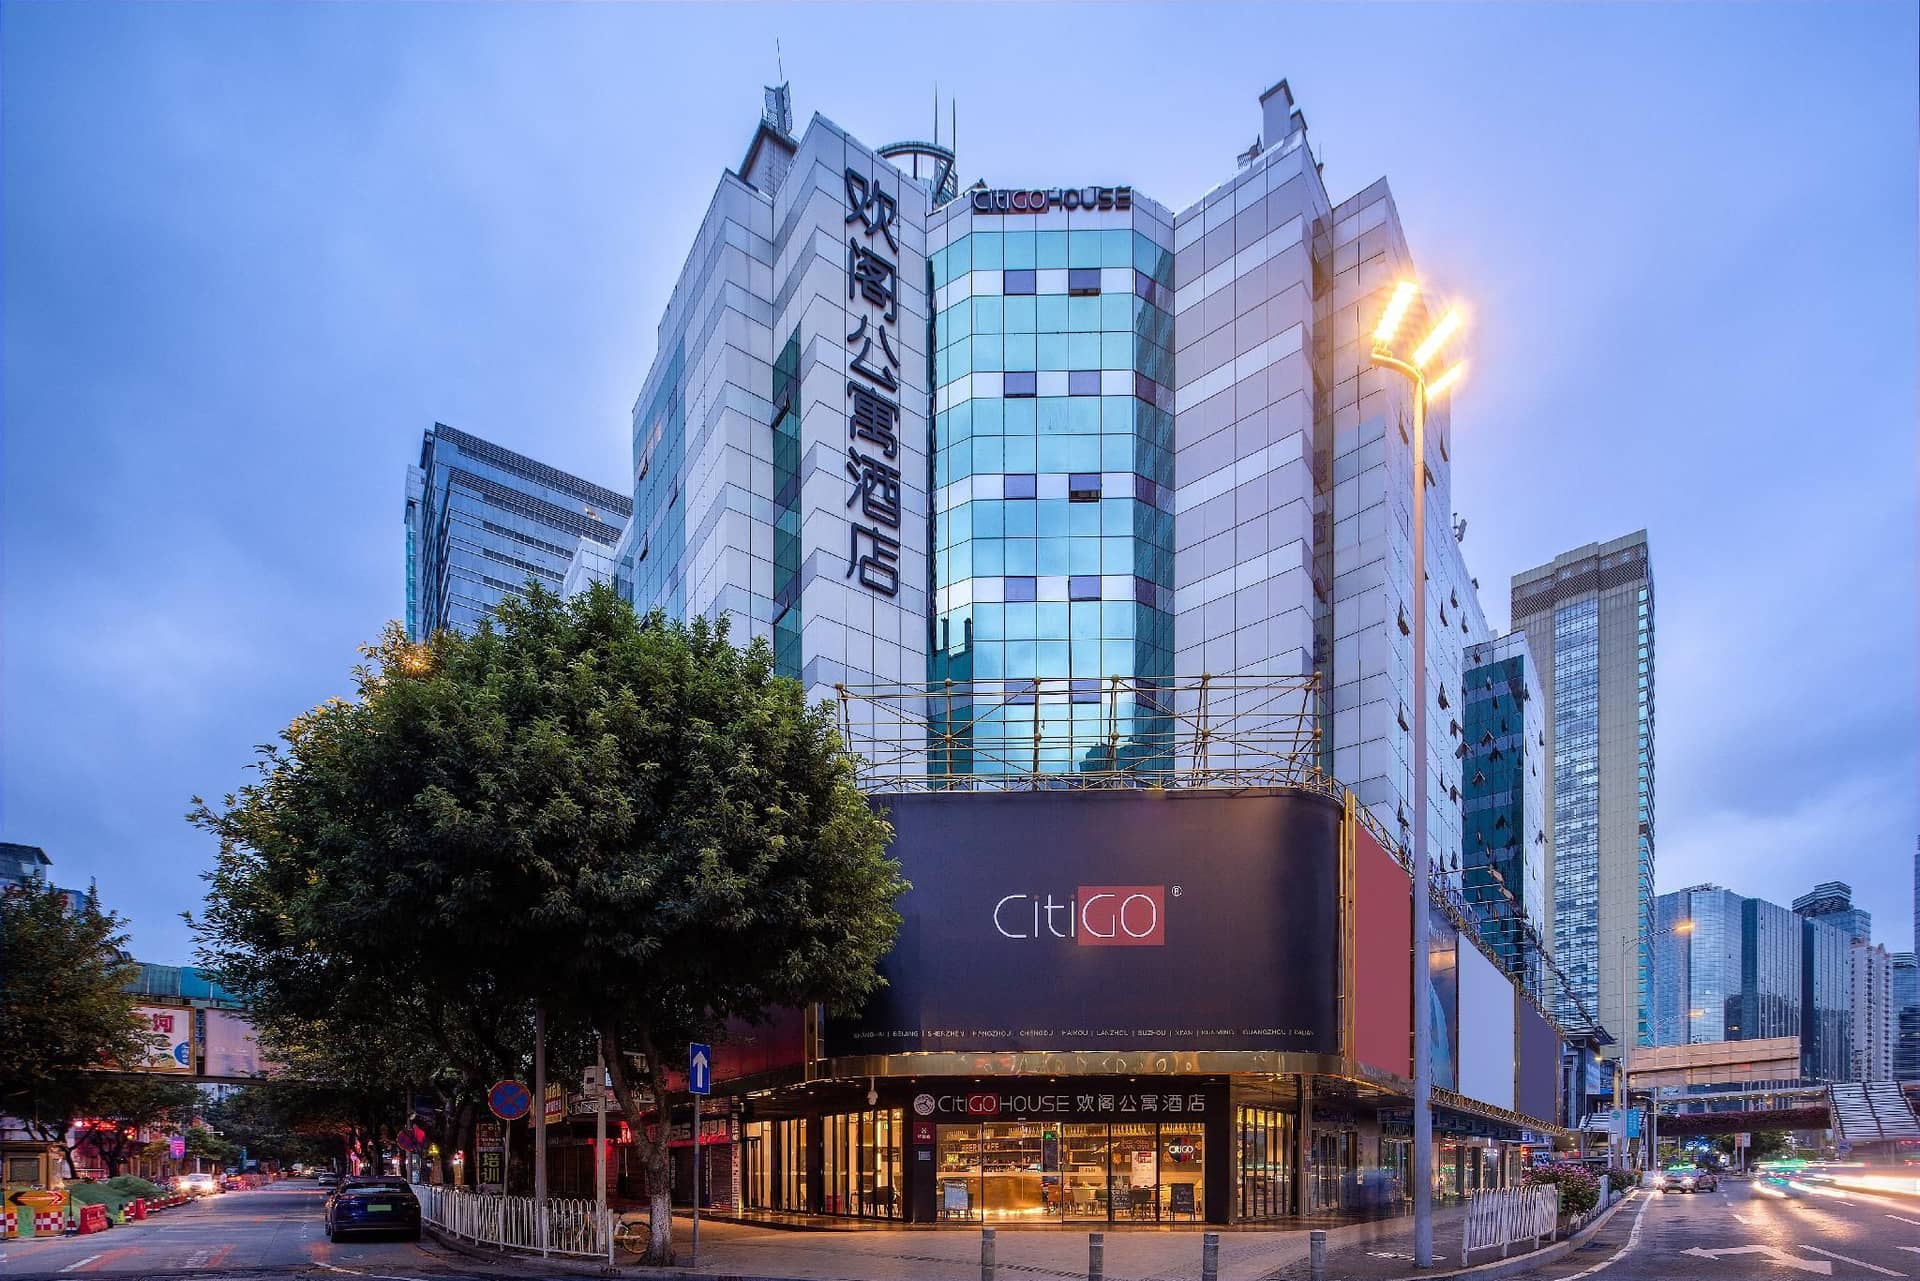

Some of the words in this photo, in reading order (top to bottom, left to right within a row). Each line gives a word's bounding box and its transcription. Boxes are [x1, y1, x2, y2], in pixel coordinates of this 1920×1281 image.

[845, 166, 900, 597] 欢阁公寓酒店
[1076, 1094, 1205, 1112] 欢阁公寓酒店
[481, 1153, 500, 1183] 培训
